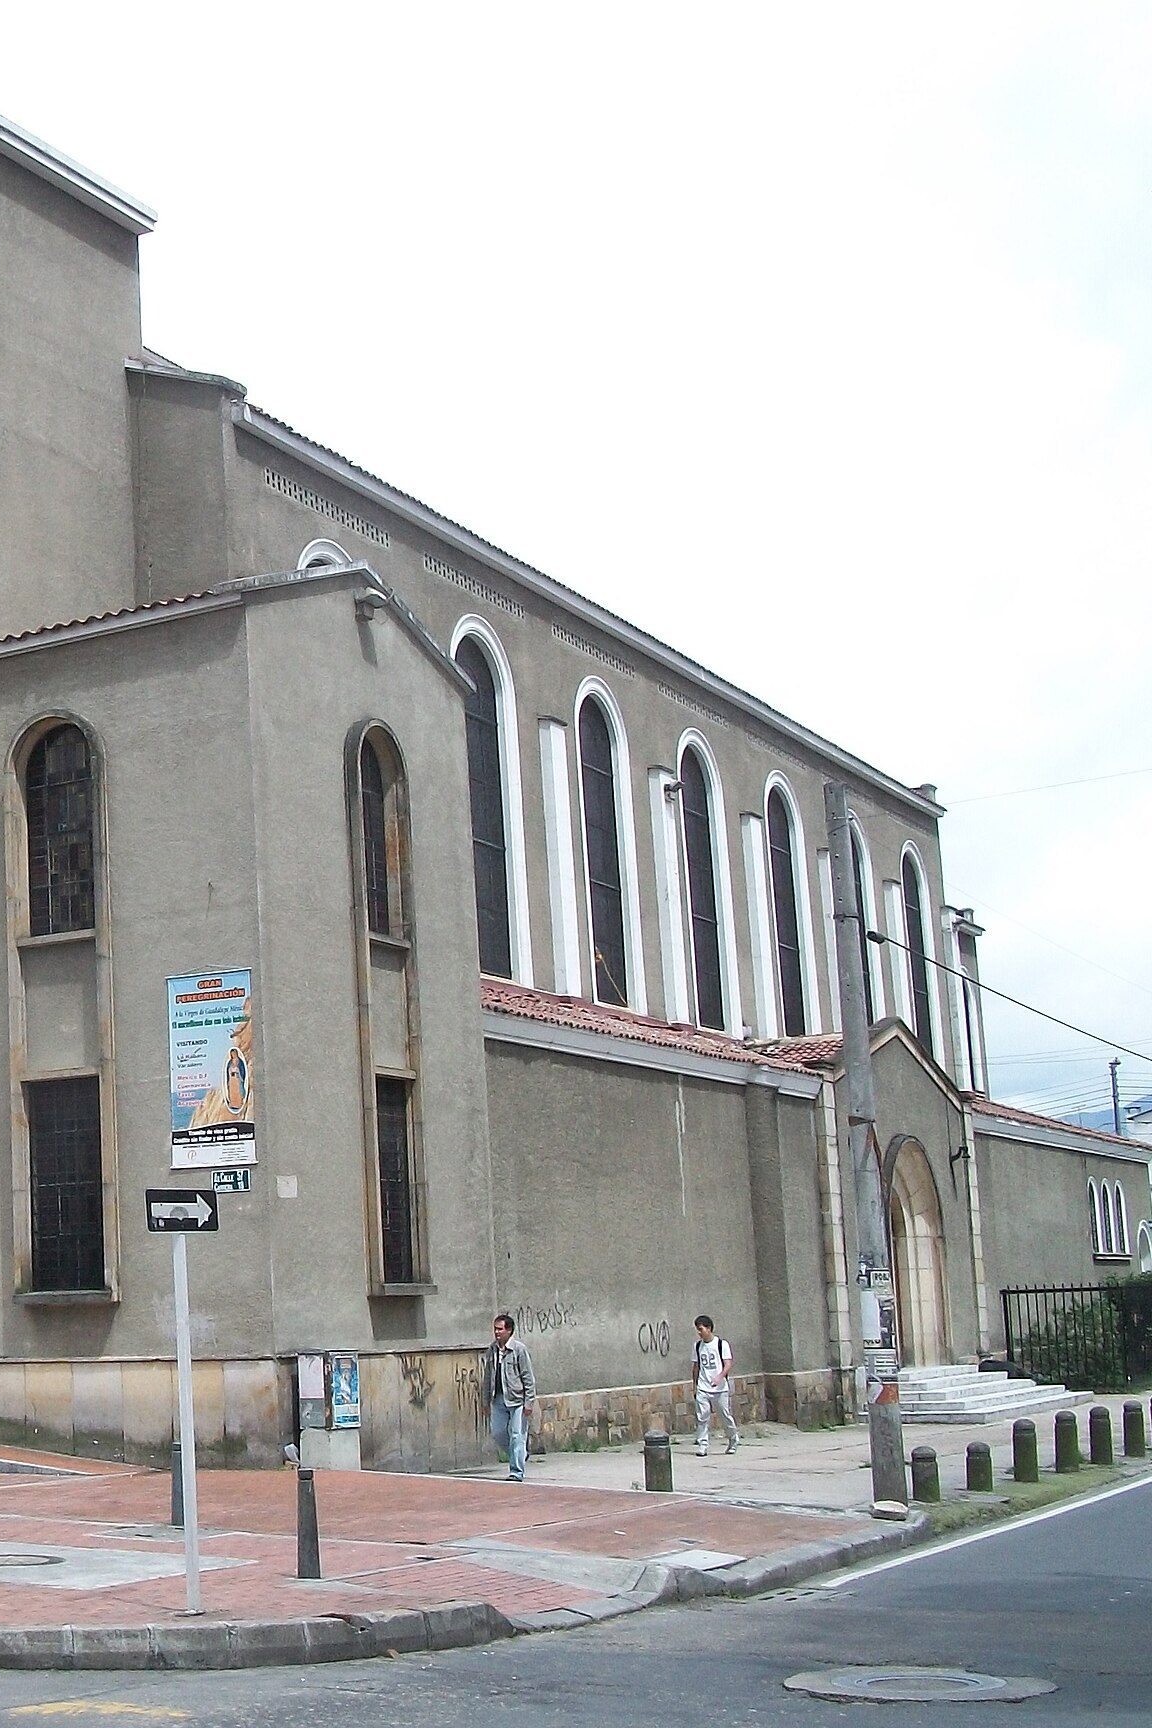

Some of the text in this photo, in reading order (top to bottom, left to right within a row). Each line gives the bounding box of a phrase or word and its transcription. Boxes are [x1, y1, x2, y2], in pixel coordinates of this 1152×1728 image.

[198, 979, 222, 989] GRAN
[176, 988, 245, 1003] PEREGRINACIÓN
[176, 1039, 208, 1047] VISITANDO
[700, 1353, 716, 1366] 82
